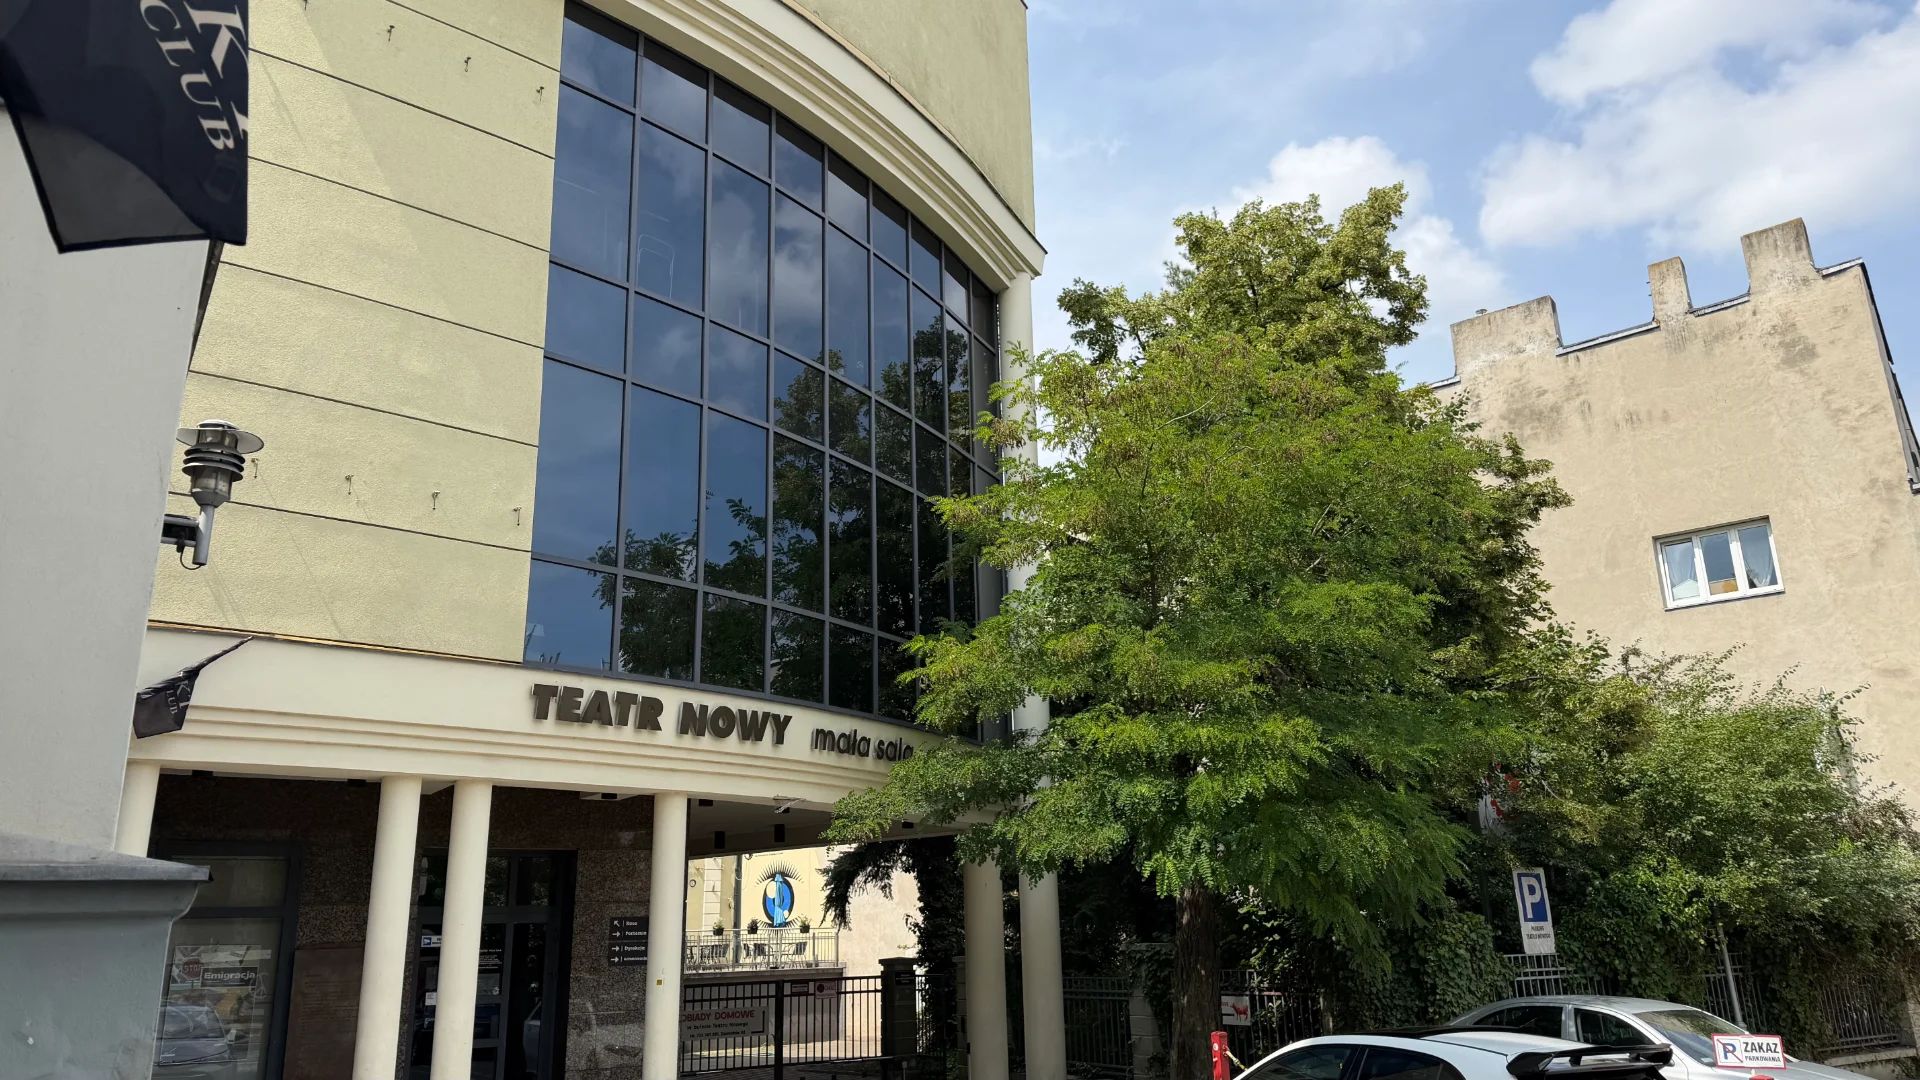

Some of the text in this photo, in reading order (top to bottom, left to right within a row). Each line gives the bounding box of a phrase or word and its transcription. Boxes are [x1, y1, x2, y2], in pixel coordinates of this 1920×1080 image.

[140, 0, 235, 150] CLUB
[531, 683, 664, 731] TEATR
[677, 701, 793, 745] NOWY
[873, 737, 914, 761] sala
[1520, 876, 1542, 919] P
[203, 970, 256, 981] Emigracja
[714, 1010, 756, 1020] DOMOWE
[1743, 1041, 1780, 1053] ZAKAZ
